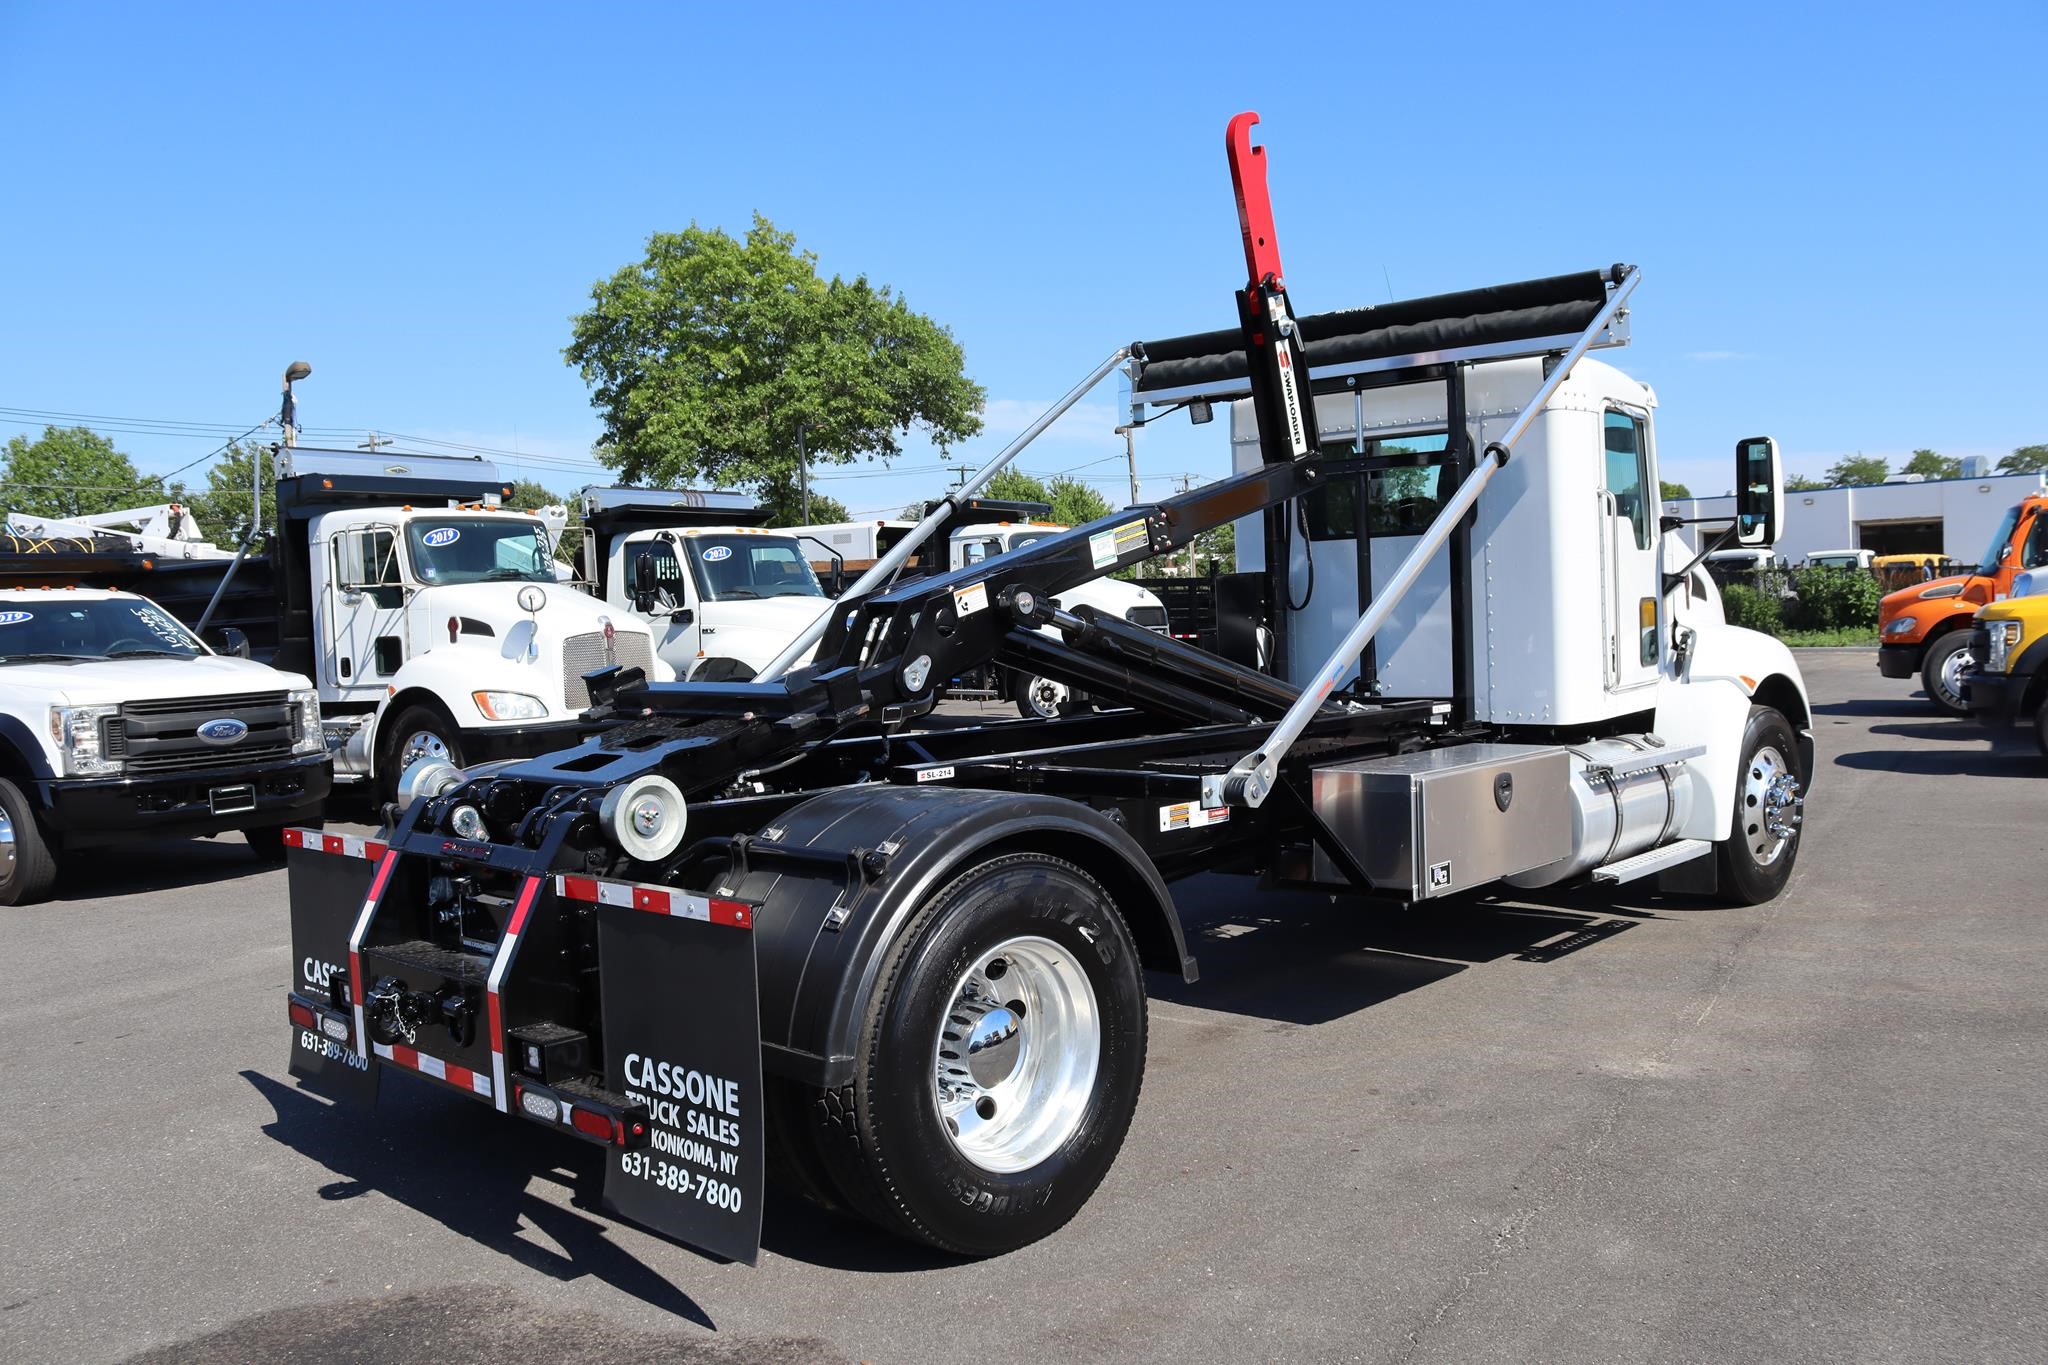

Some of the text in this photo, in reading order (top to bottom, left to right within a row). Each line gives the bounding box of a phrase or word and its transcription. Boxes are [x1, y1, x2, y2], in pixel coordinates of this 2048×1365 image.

[1283, 370, 1301, 446] SWAPLOADER
[431, 529, 454, 544] 2019
[708, 548, 726, 560] 2021
[0, 612, 23, 622] 019
[212, 725, 237, 737] Ford
[926, 769, 952, 779] SL-214
[301, 1031, 369, 1071] 631-389-7800
[624, 1053, 740, 1117] CASSONE
[686, 1109, 740, 1147] SALES
[720, 1151, 739, 1176] NY
[621, 1151, 742, 1213] 631-389-7800
